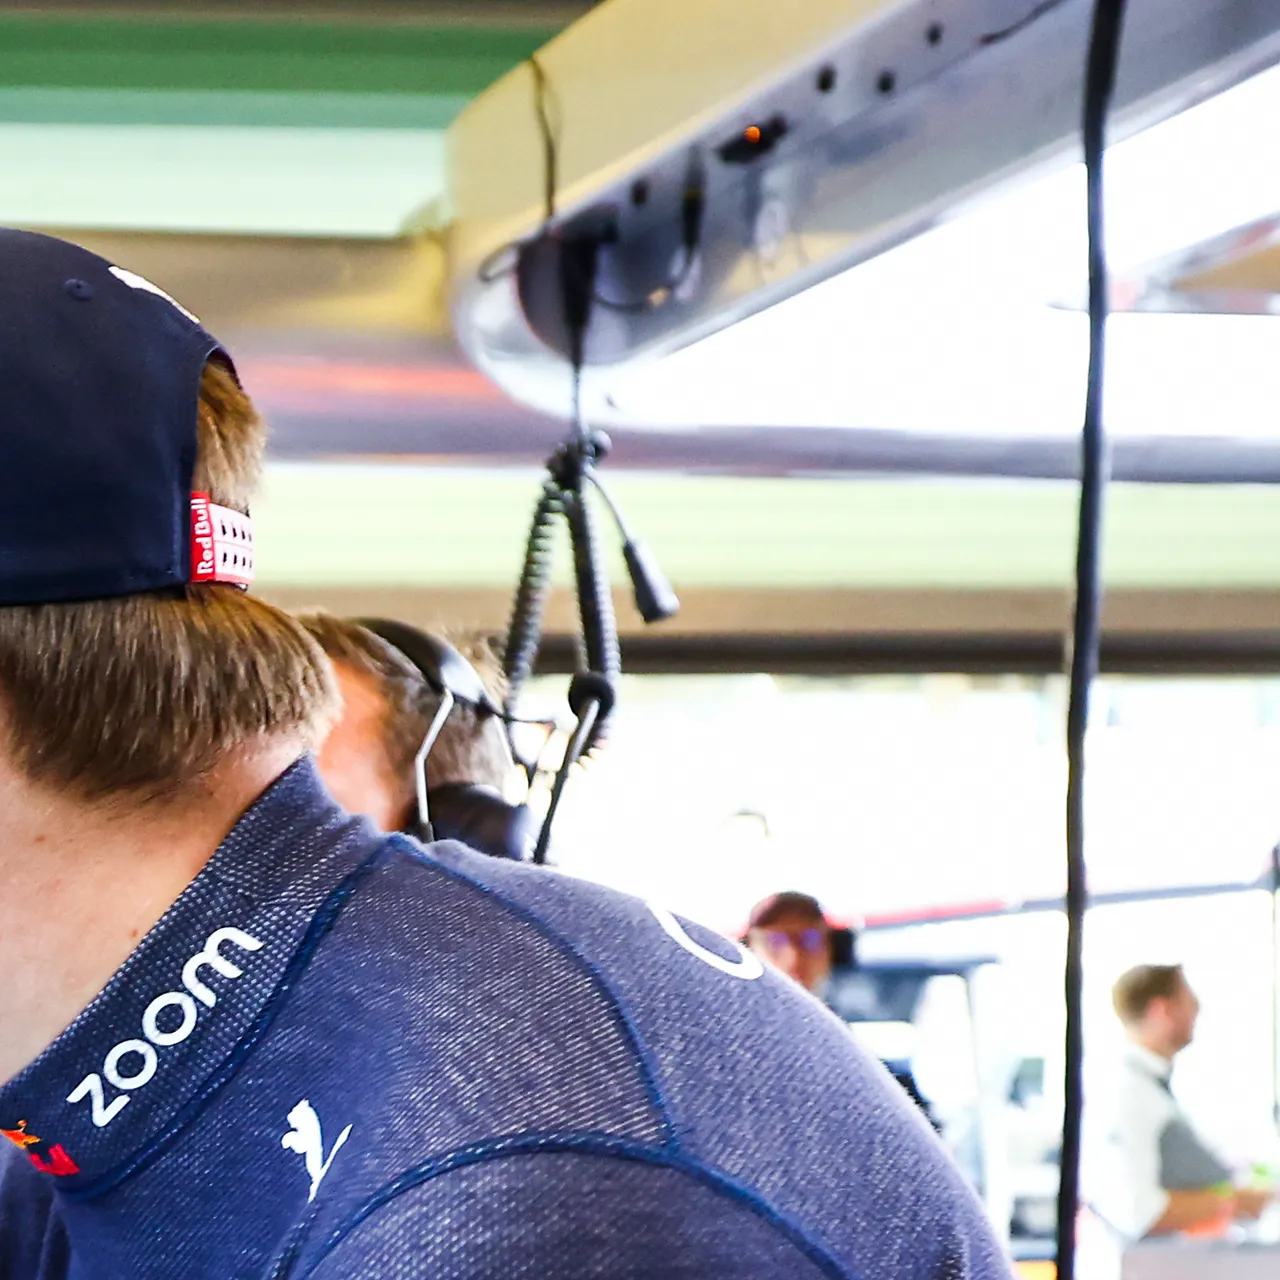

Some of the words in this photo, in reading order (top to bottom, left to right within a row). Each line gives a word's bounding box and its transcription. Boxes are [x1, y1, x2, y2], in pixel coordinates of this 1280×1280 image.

[190, 498, 211, 535] Bull
[195, 537, 214, 574] Red
[66, 926, 264, 1128] zoom
